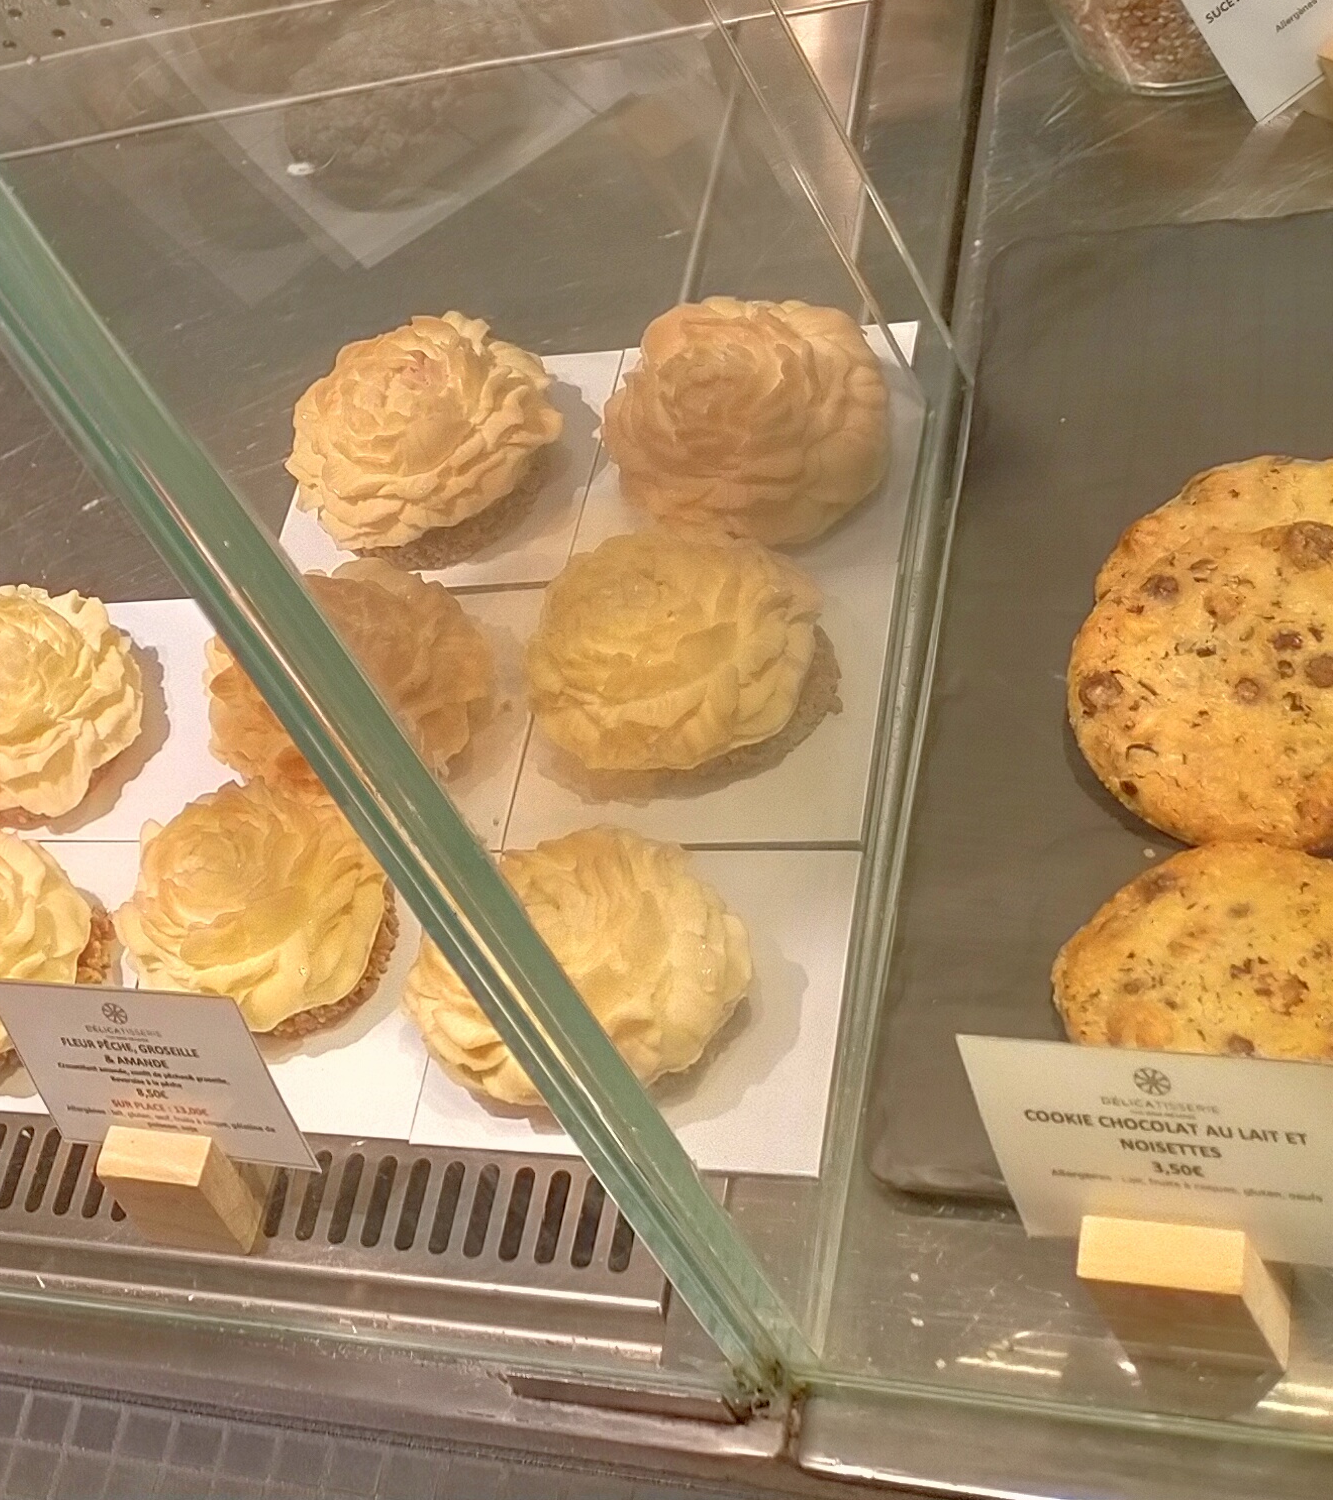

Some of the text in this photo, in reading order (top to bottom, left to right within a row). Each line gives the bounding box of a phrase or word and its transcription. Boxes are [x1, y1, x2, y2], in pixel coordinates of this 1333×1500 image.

[60, 1036, 96, 1050] FLEUR
[138, 1043, 200, 1058] GROSEILLE
[116, 1055, 169, 1070] AMANDE
[1024, 1109, 1094, 1128] COOKIE
[1098, 1114, 1198, 1137] CHOCOLAT
[1205, 1124, 1233, 1140] AU
[1238, 1128, 1279, 1145] LAIT
[1285, 1132, 1308, 1147] ET
[1119, 1137, 1223, 1160] NOISETTES
[1151, 1160, 1205, 1178] 3,50€
